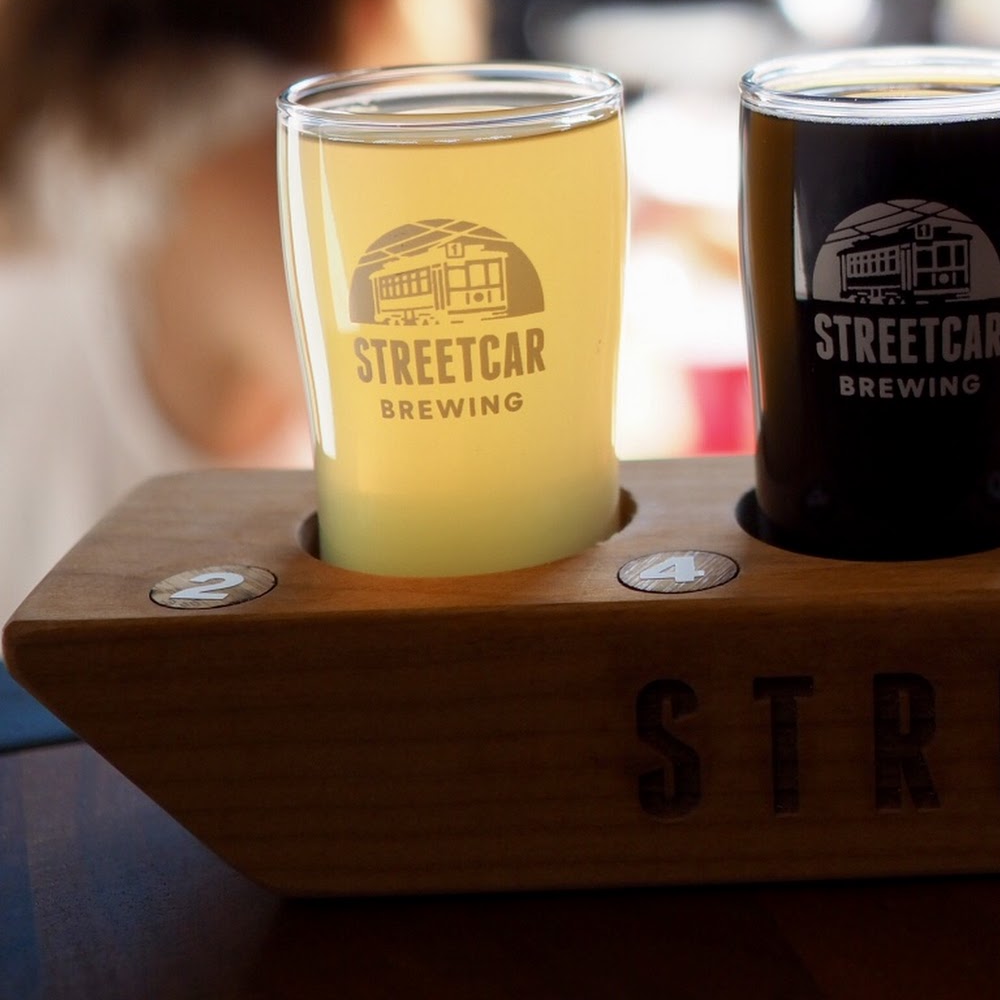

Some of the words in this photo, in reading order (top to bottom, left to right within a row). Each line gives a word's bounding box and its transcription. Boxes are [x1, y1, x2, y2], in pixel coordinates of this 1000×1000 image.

[353, 327, 546, 386] STREETCAR
[839, 374, 981, 399] BREWING
[380, 391, 524, 420] BREWING
[640, 556, 705, 584] 4
[169, 572, 245, 601] 2
